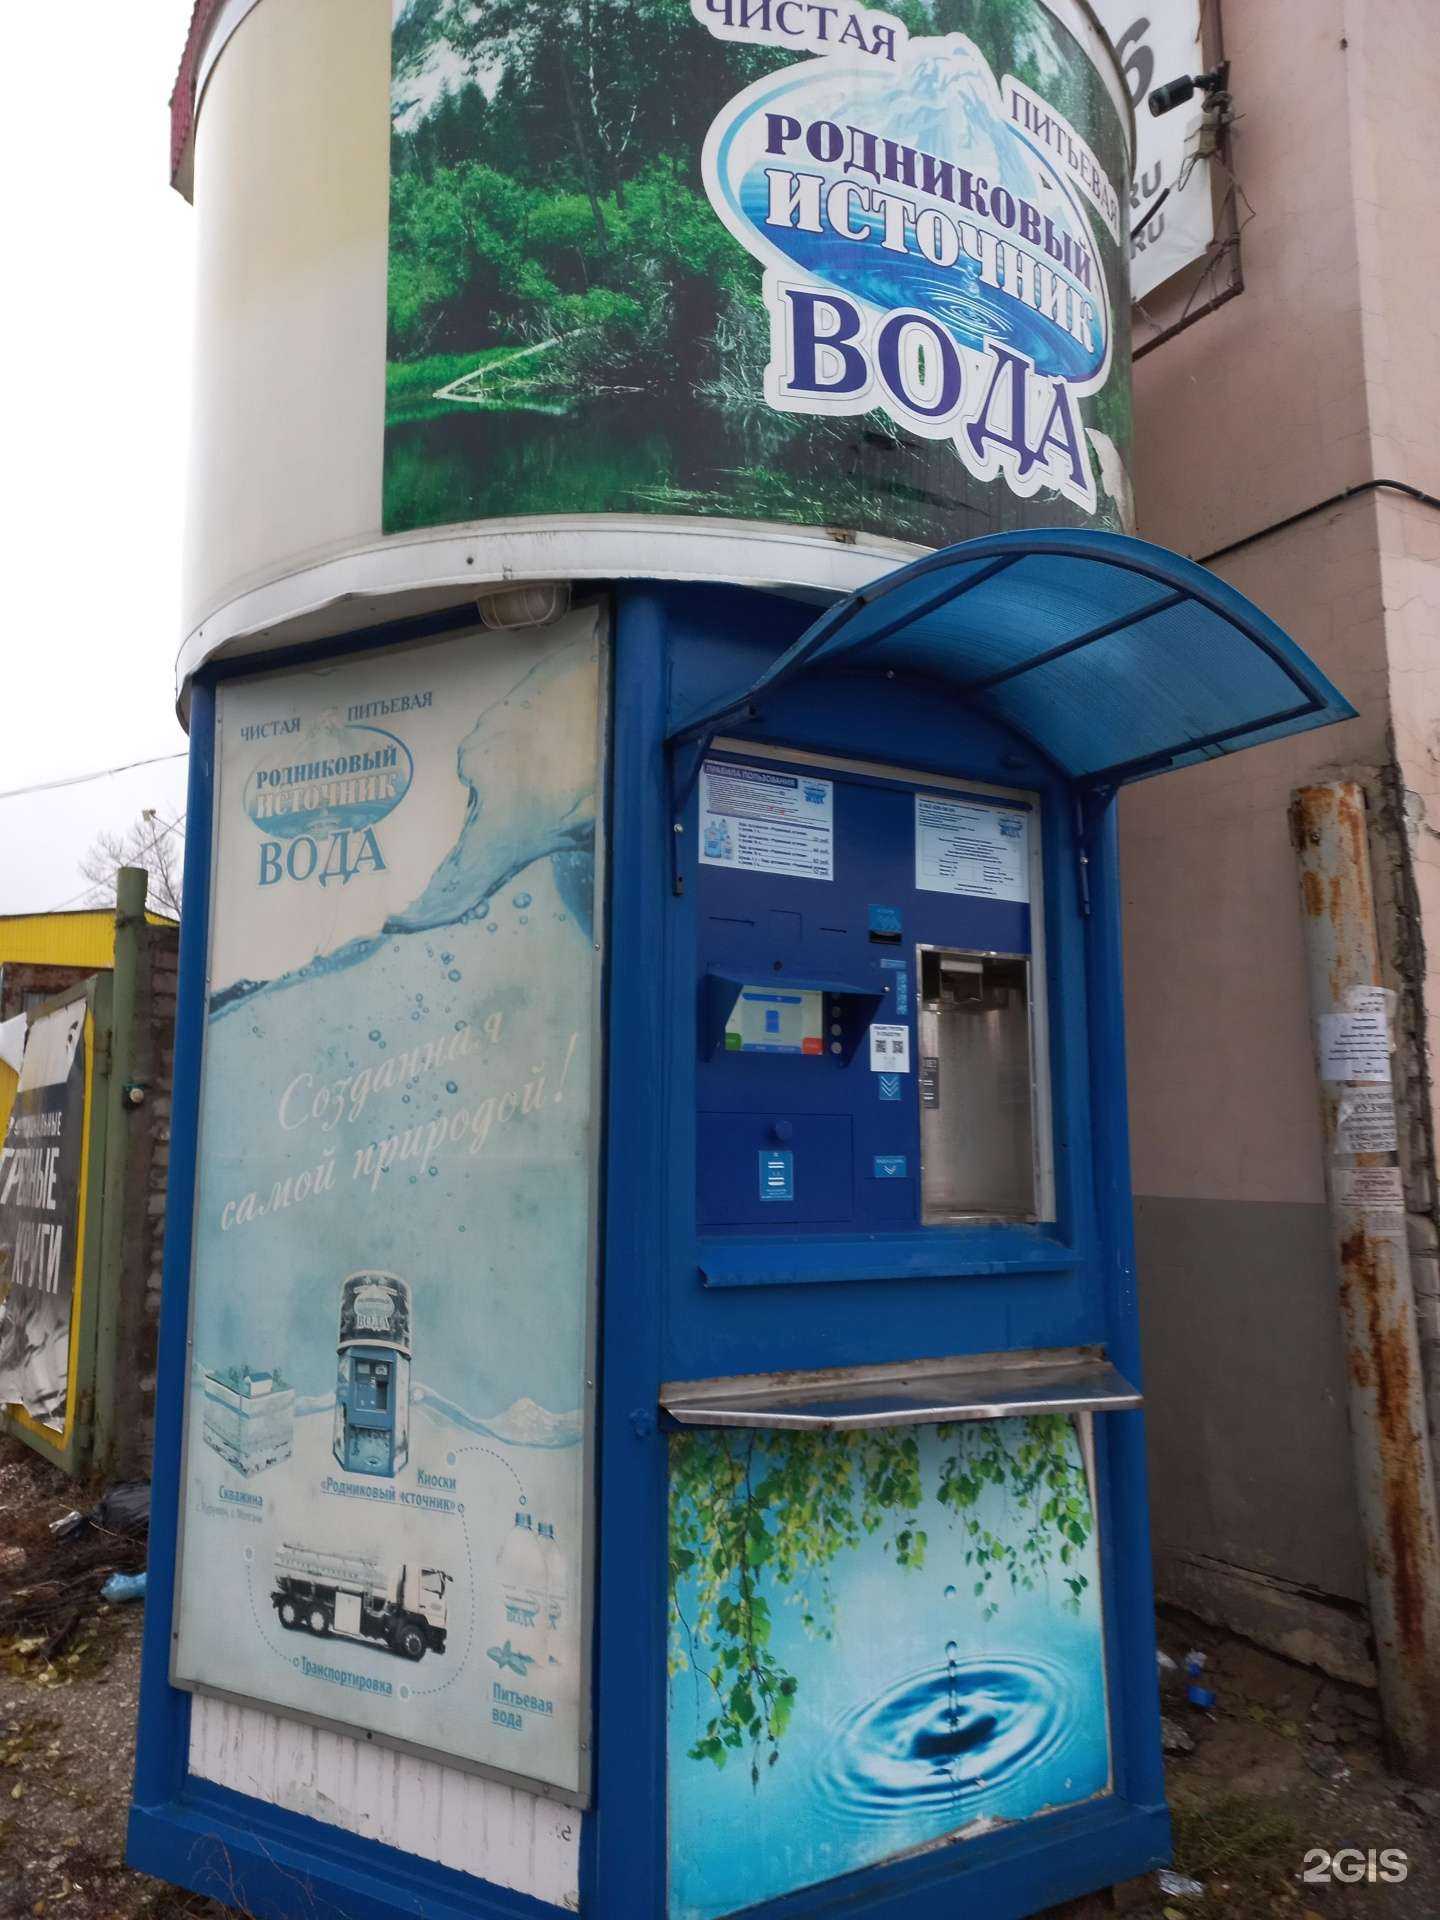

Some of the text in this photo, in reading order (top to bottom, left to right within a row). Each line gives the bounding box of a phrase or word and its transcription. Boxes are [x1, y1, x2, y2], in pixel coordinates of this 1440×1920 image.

[706, 0, 898, 62] ЧИСТАЯ
[1008, 90, 1119, 224] ПИТЬЕВАЯ
[765, 112, 1092, 290] РОДНИКОВЫЙ
[764, 167, 1096, 353] ИСТОЧНИК
[785, 288, 1090, 492] ВОДА
[240, 691, 434, 743] ЧИСТАЯ ПИТЬЕВАЯ
[256, 743, 398, 790] РОДНИКОВЫЙ
[256, 773, 398, 820] ИСТОЧНИК
[257, 826, 387, 888] ВОДА
[221, 1032, 577, 1231] самой природой!
[219, 1484, 263, 1506] Скважина
[320, 1476, 396, 1502] «Родниковый
[416, 1469, 457, 1490] Киоски
[301, 1655, 393, 1695] Транспортировка
[492, 1681, 553, 1714] Питьевая
[492, 1709, 522, 1728] вода
